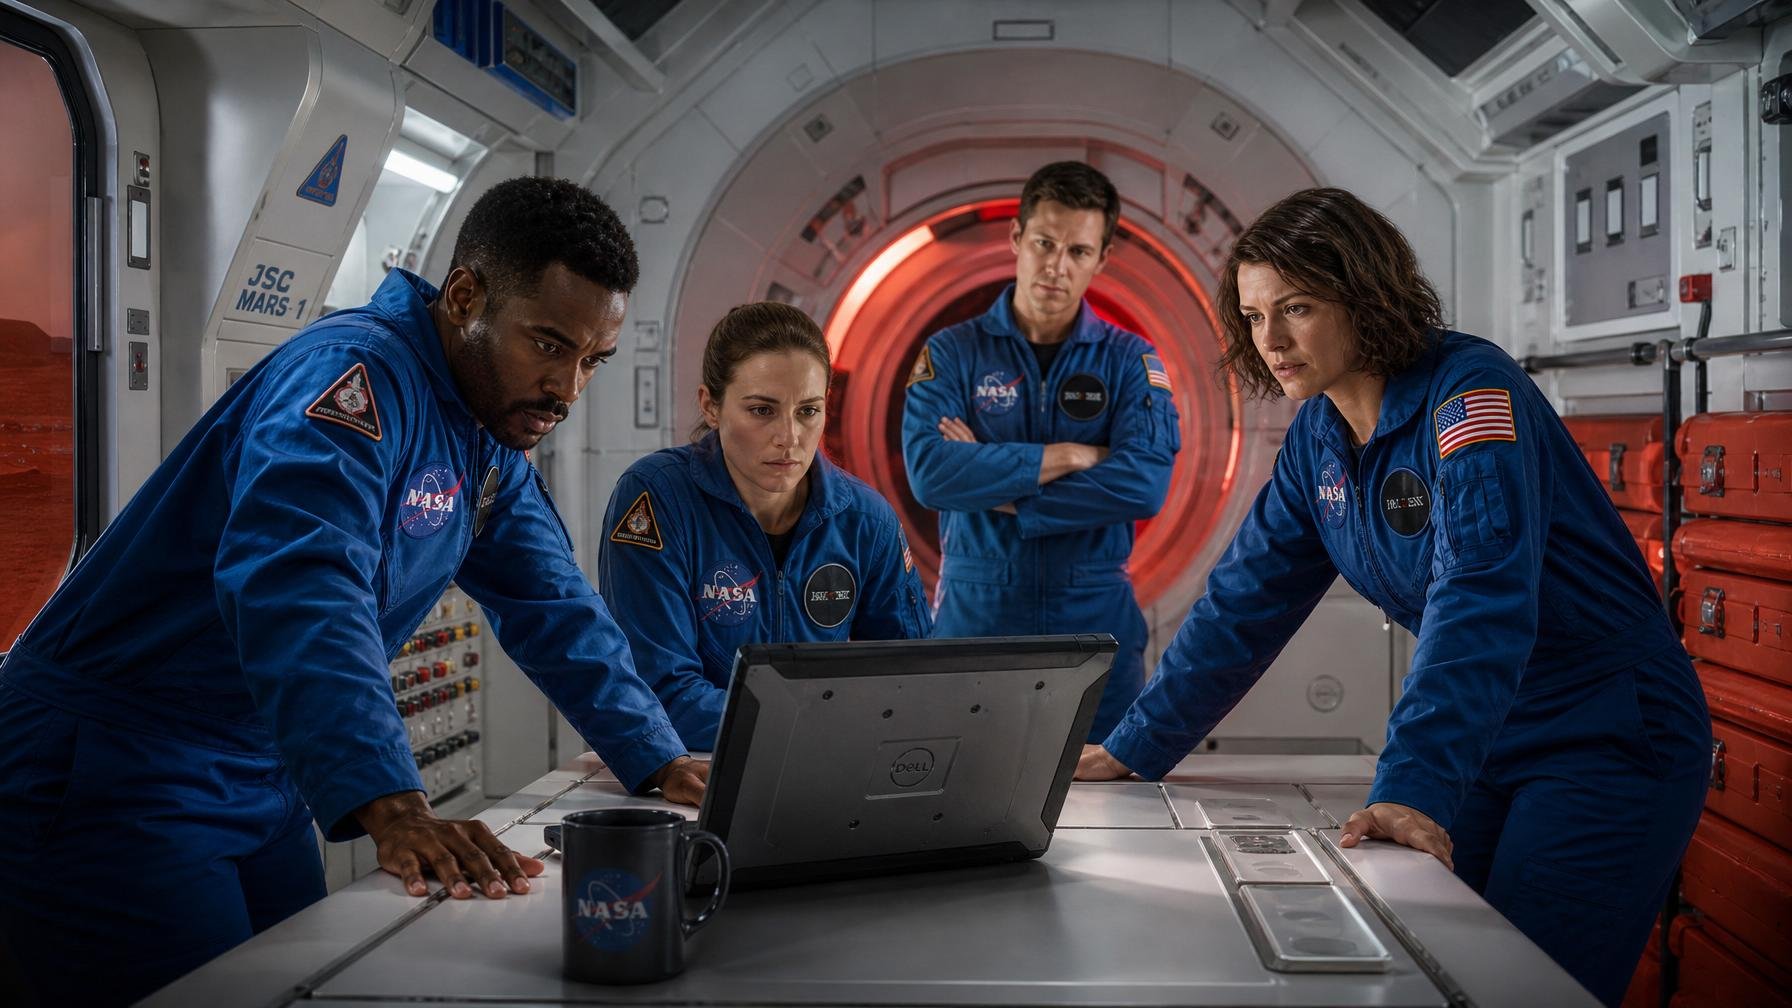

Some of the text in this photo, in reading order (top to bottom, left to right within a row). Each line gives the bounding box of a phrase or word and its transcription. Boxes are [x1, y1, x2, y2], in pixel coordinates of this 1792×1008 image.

[248, 264, 295, 293] JSC
[976, 385, 1018, 397] NASA
[406, 488, 454, 512] NASA
[1318, 485, 1346, 502] NASA
[702, 583, 758, 602] NASA
[895, 761, 929, 773] DELL
[578, 898, 648, 919] NASA
